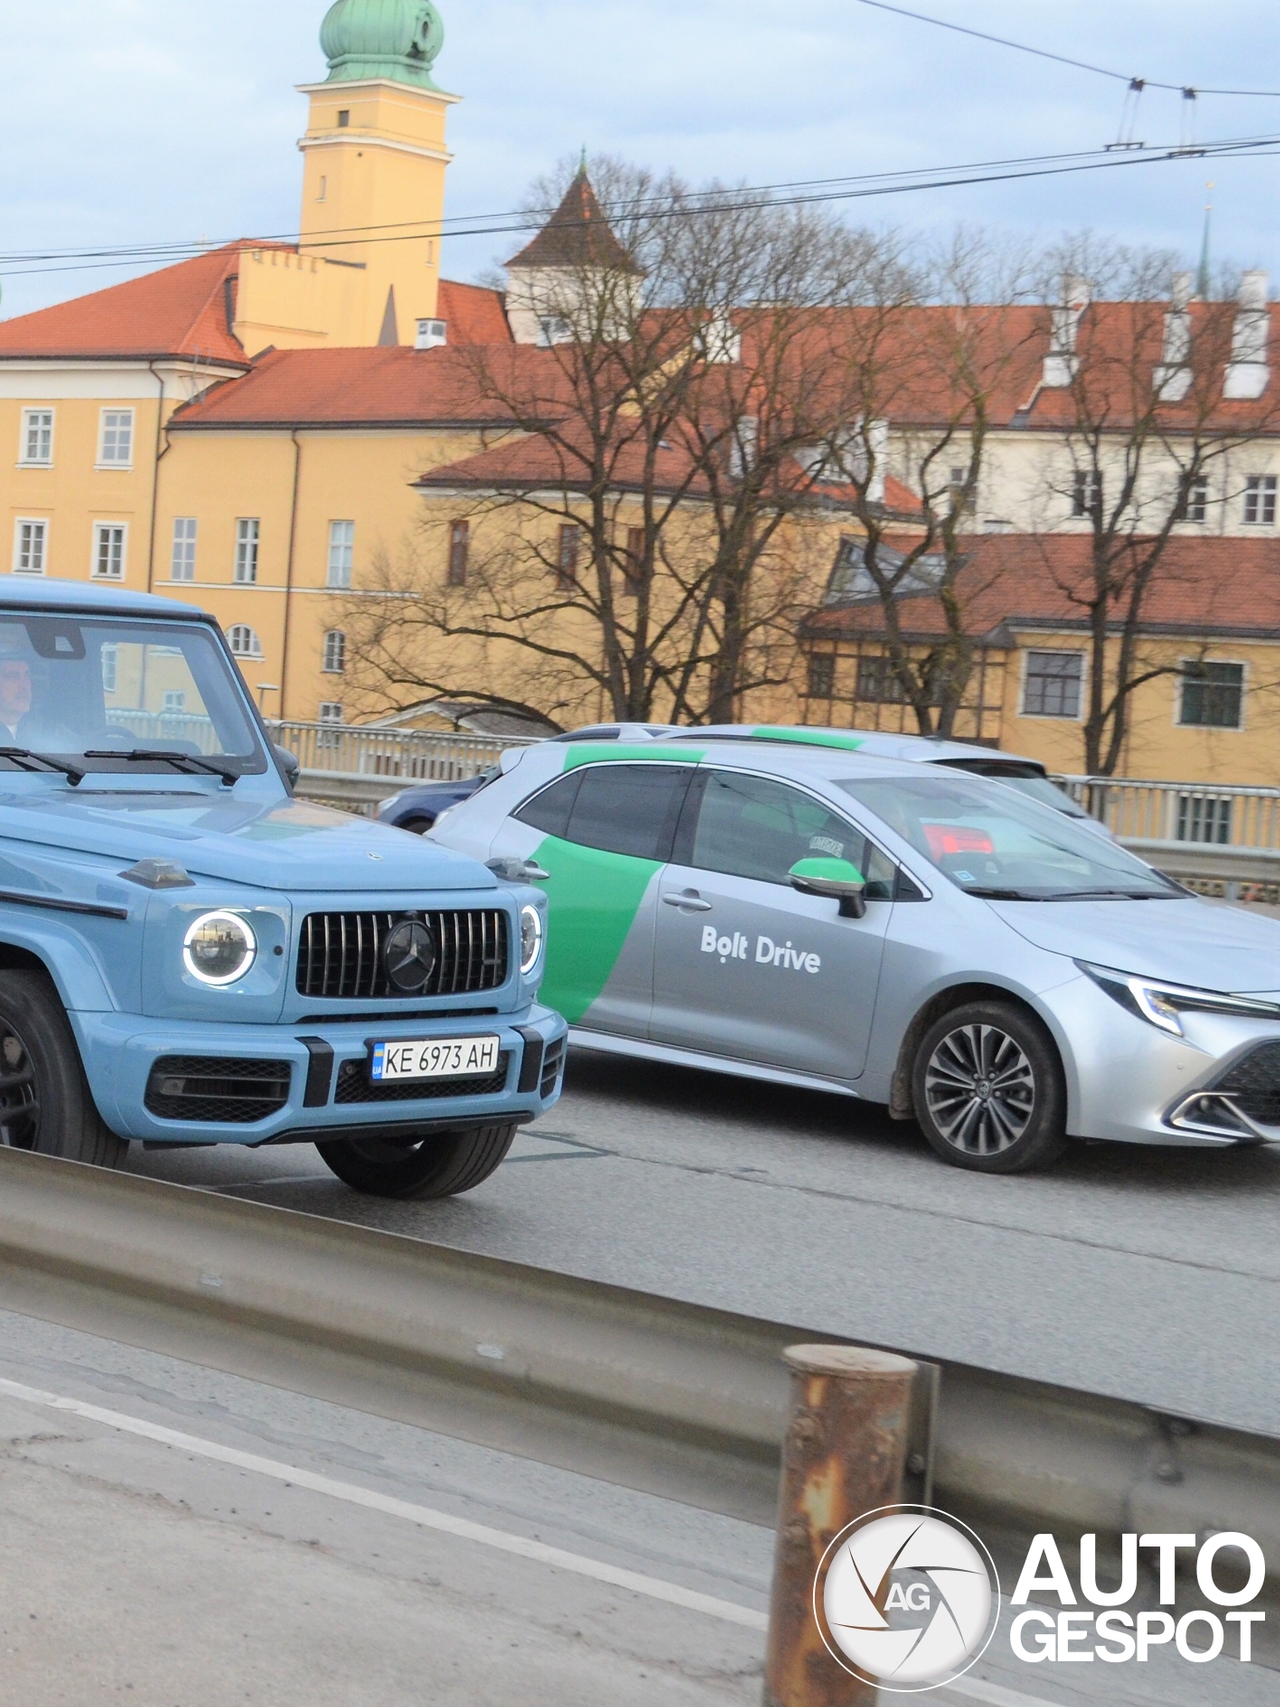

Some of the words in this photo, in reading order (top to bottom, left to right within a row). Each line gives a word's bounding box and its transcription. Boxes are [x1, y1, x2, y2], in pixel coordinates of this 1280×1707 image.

[700, 925, 748, 964] Bolt
[755, 935, 821, 974] Drive
[385, 1048, 414, 1074] KE
[419, 1045, 462, 1071] 6973
[466, 1043, 493, 1068] AH
